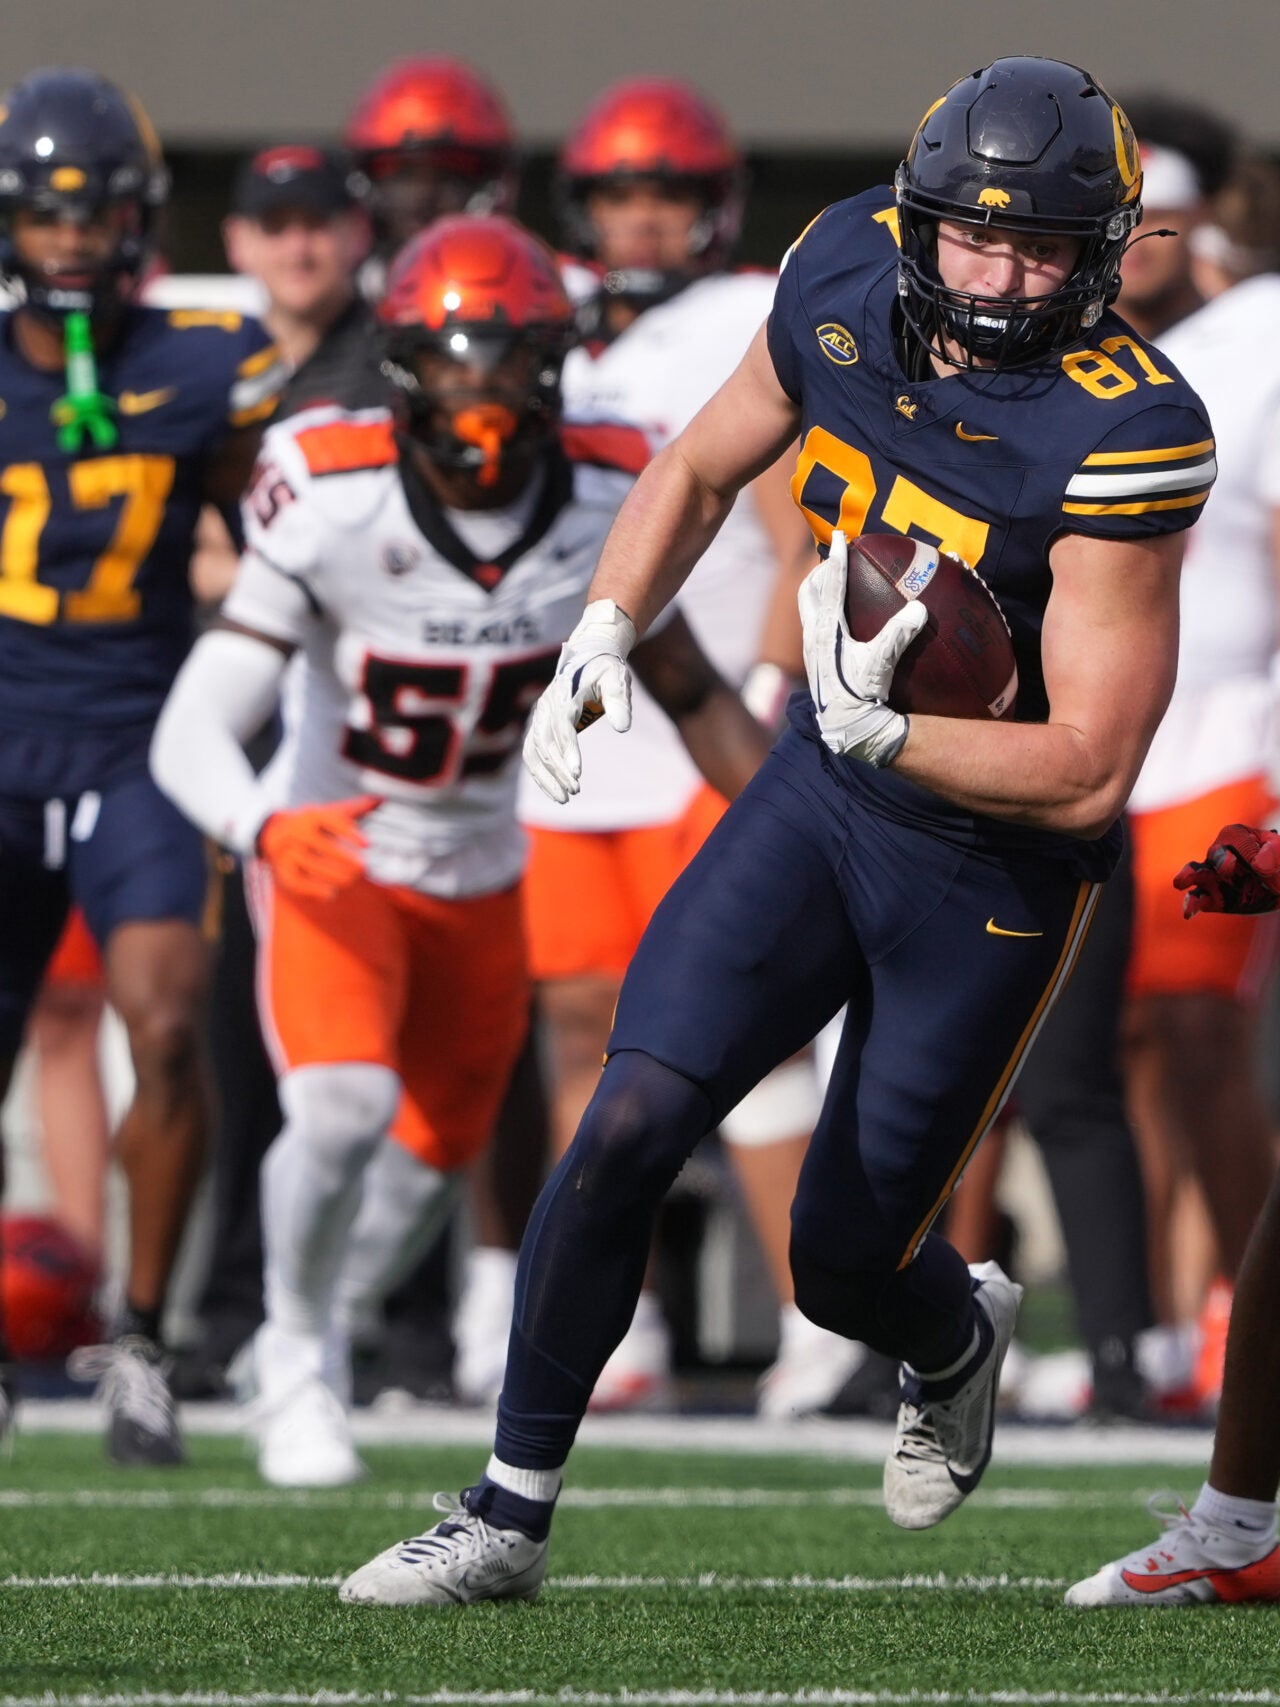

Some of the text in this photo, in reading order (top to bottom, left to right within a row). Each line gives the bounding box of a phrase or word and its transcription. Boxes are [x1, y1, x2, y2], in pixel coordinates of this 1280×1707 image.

[822, 332, 856, 355] ACC
[1061, 335, 1176, 400] 87
[895, 395, 918, 421] Cal
[0, 453, 176, 626] 17
[339, 642, 566, 790] 55
